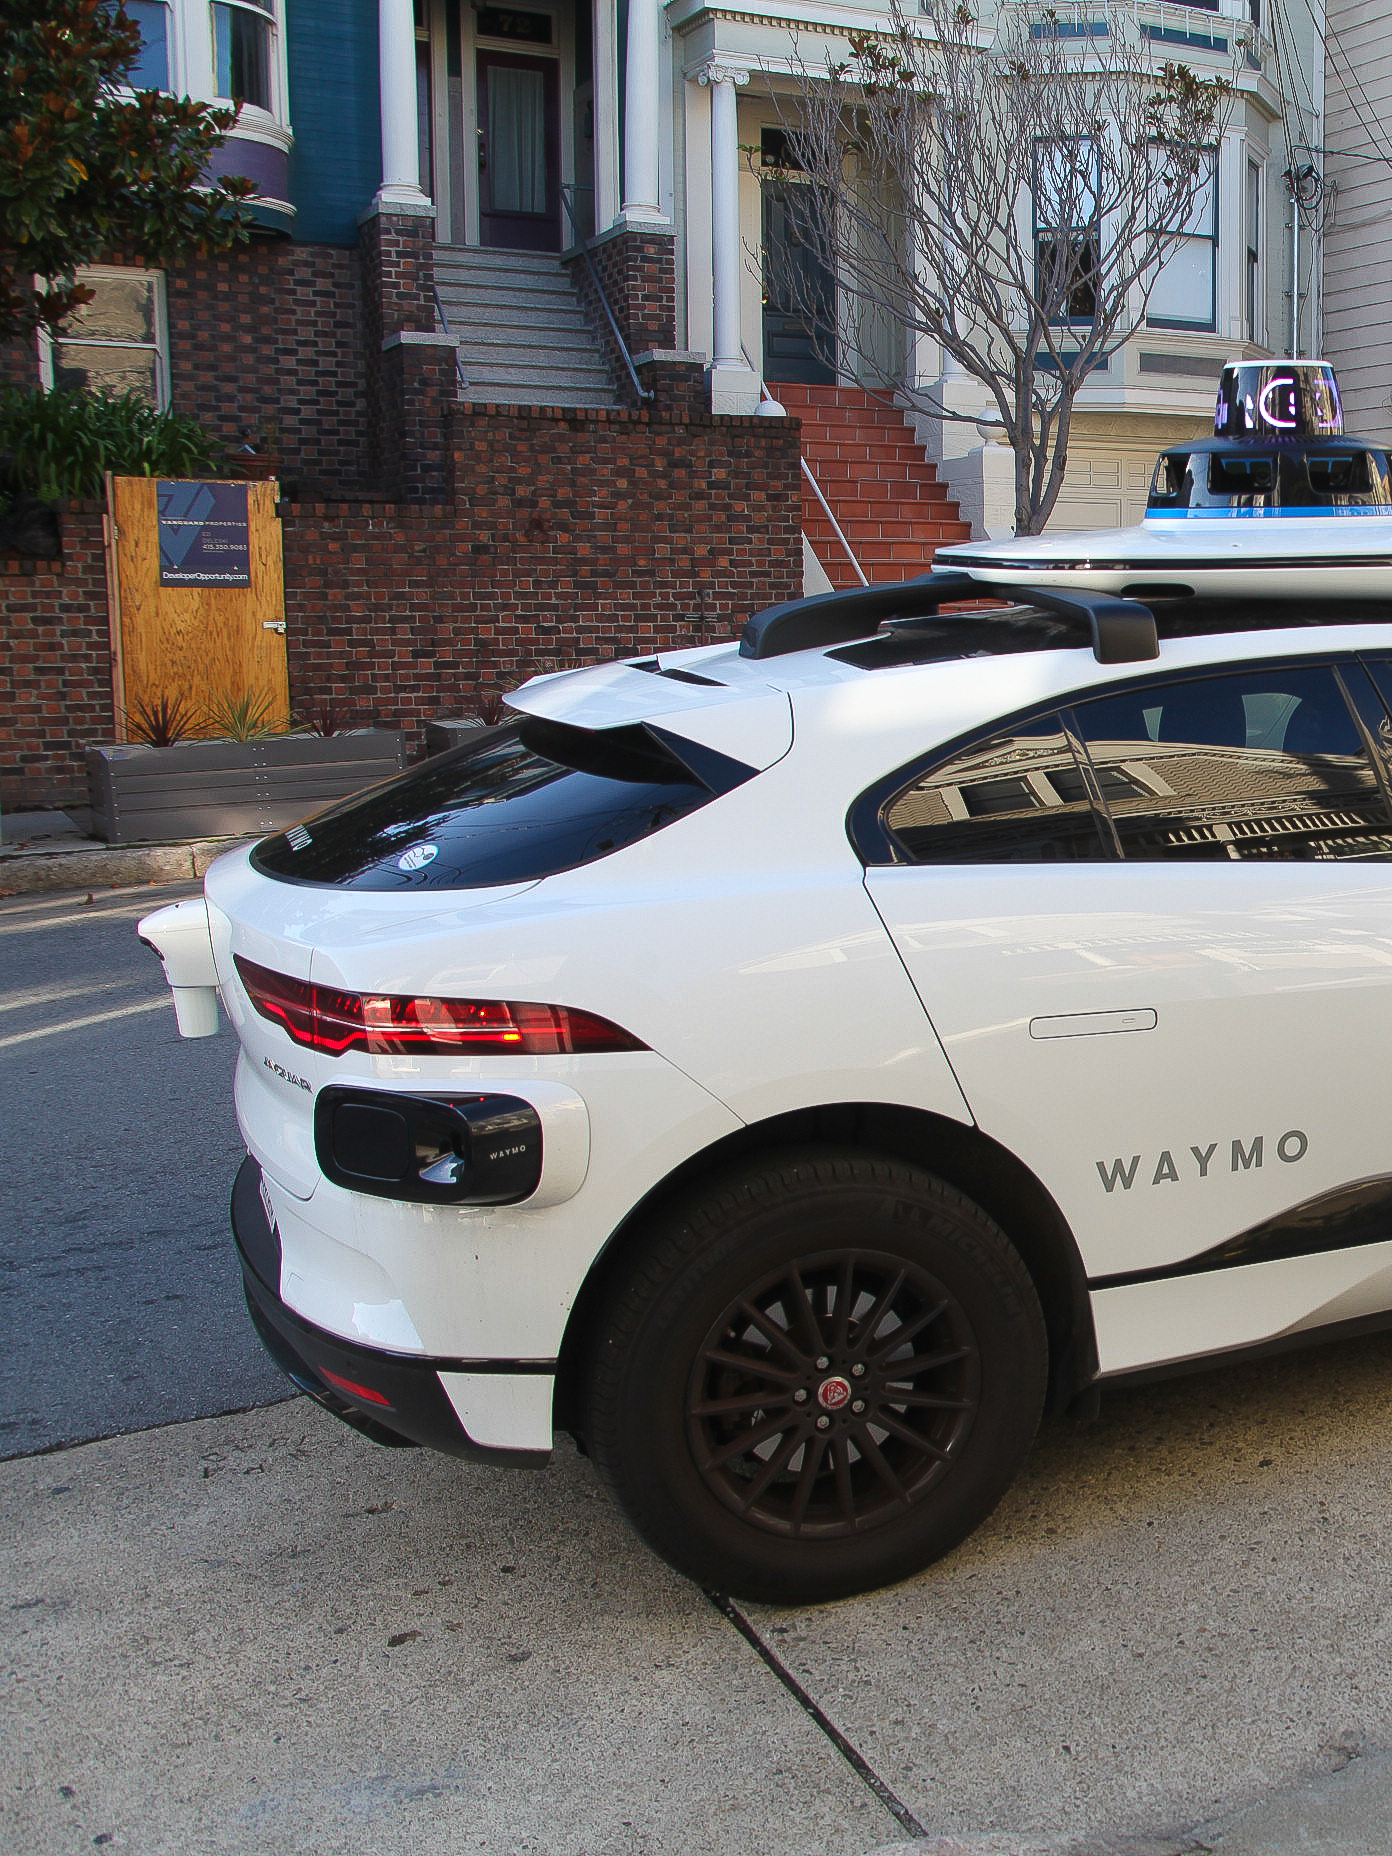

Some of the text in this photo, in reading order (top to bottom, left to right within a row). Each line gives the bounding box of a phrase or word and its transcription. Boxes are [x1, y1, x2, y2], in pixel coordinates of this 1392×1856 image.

[163, 572, 248, 581] DeveloperOpportunity.com
[285, 824, 313, 852] WAYMO
[489, 1144, 526, 1160] WAYMO
[1096, 1129, 1309, 1193] WAYMO
